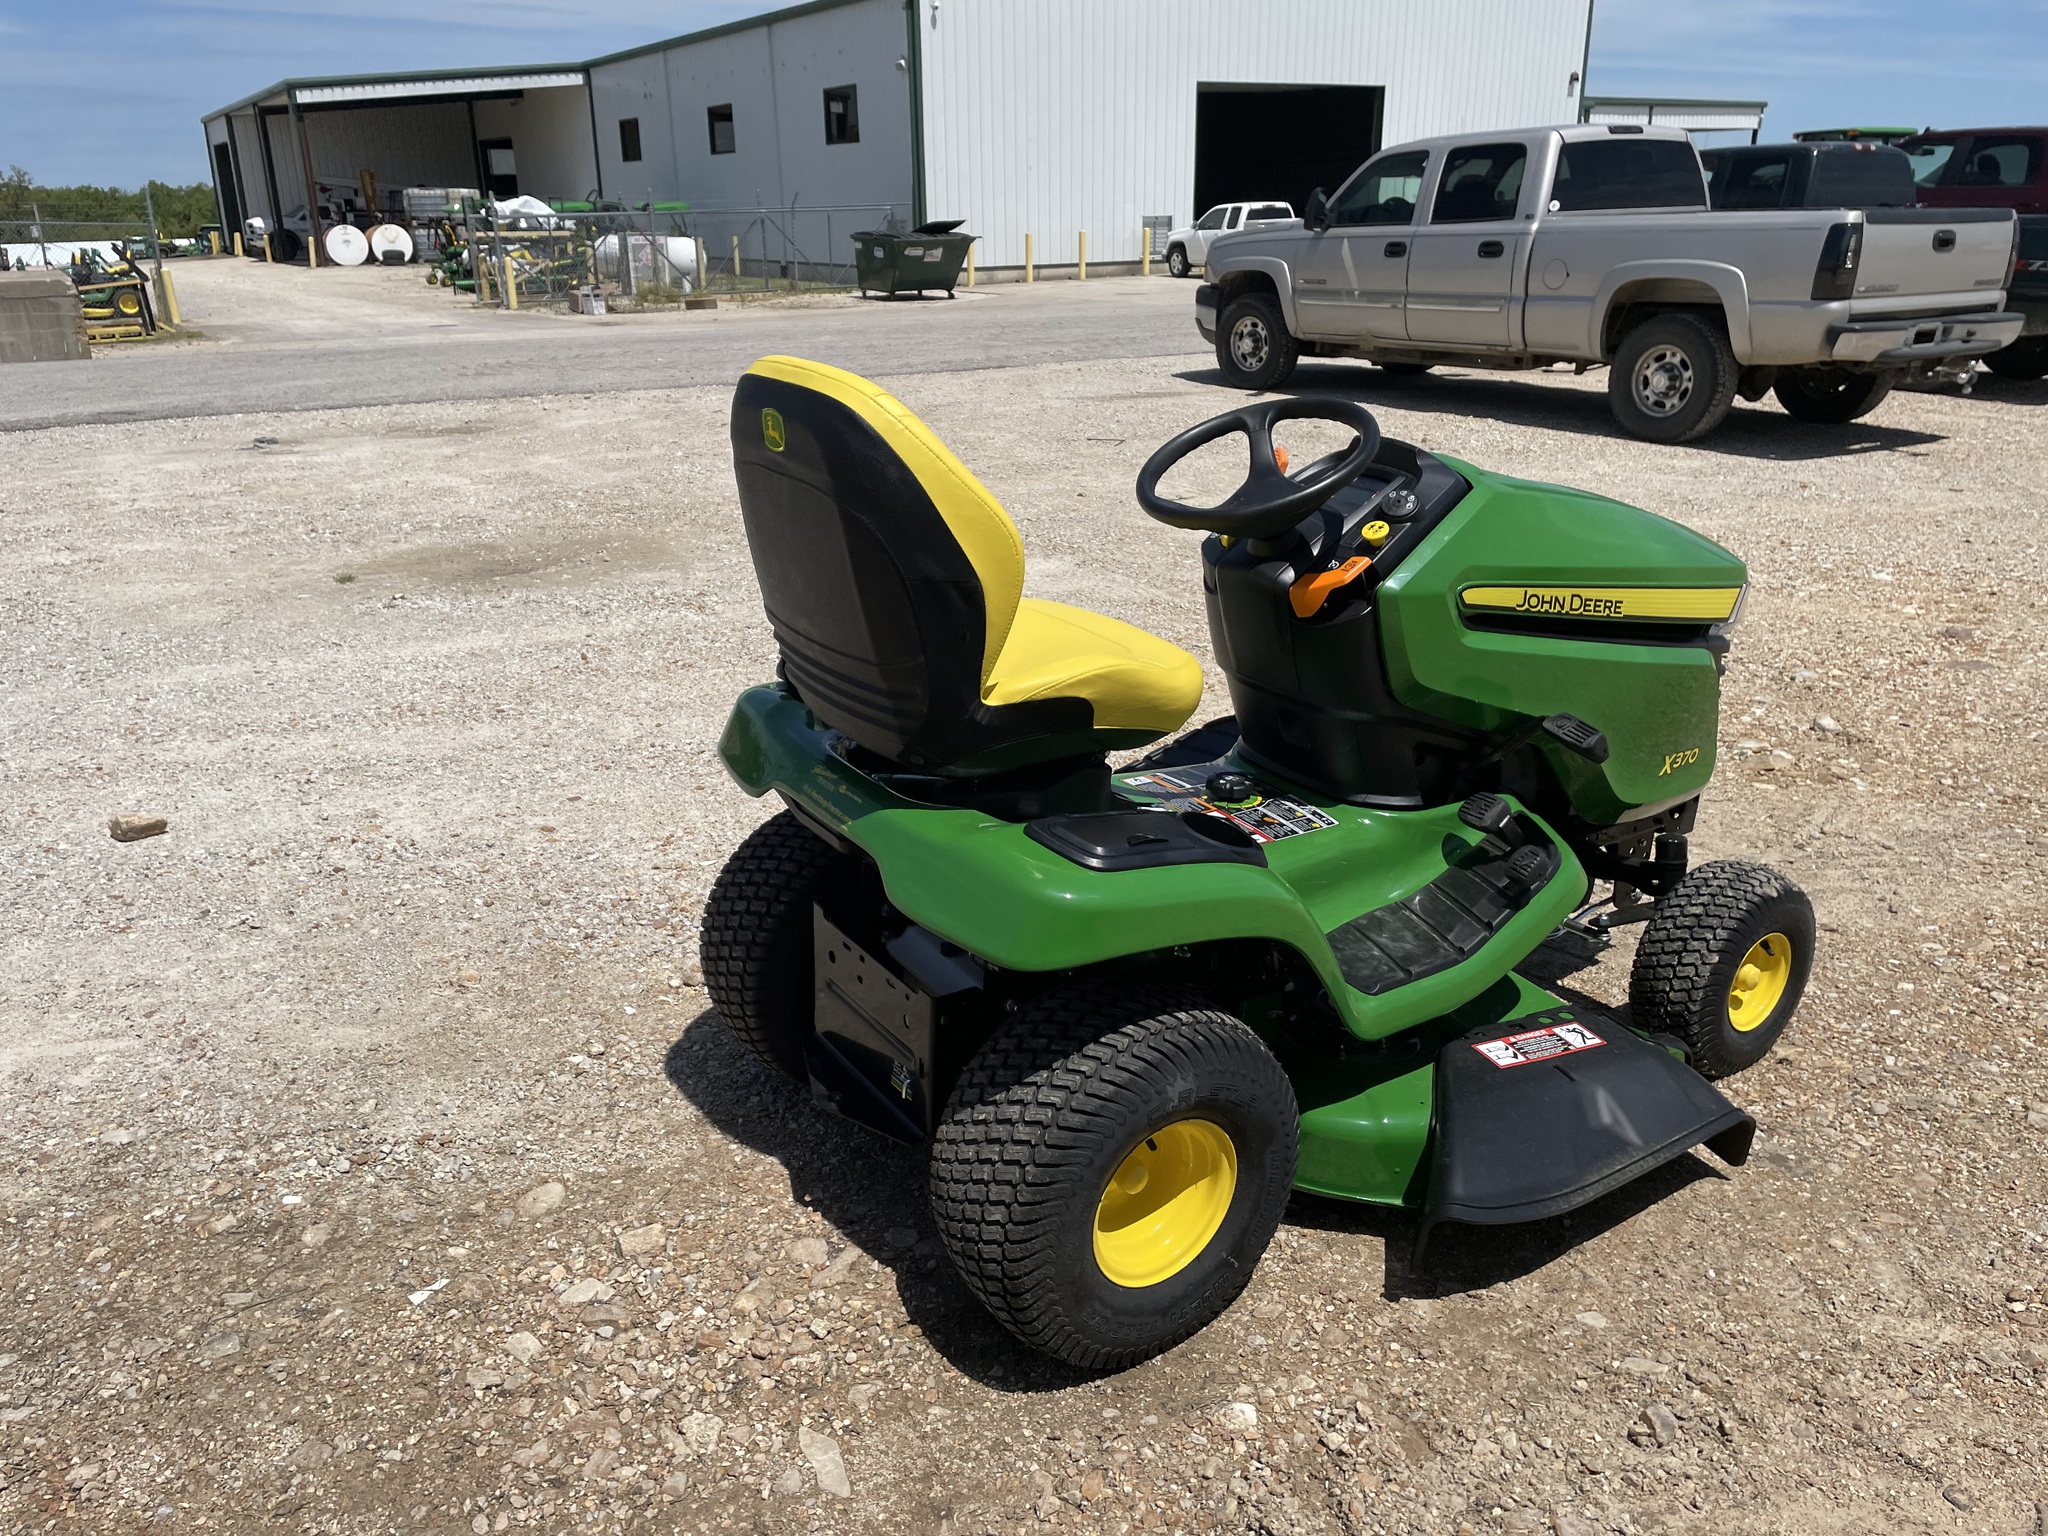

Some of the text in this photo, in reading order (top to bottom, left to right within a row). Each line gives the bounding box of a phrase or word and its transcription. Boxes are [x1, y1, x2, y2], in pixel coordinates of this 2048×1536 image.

[1516, 589, 1624, 617] JOHN DEERE
[1658, 747, 1699, 777] X370
[1515, 1029, 1549, 1041] DANGER
